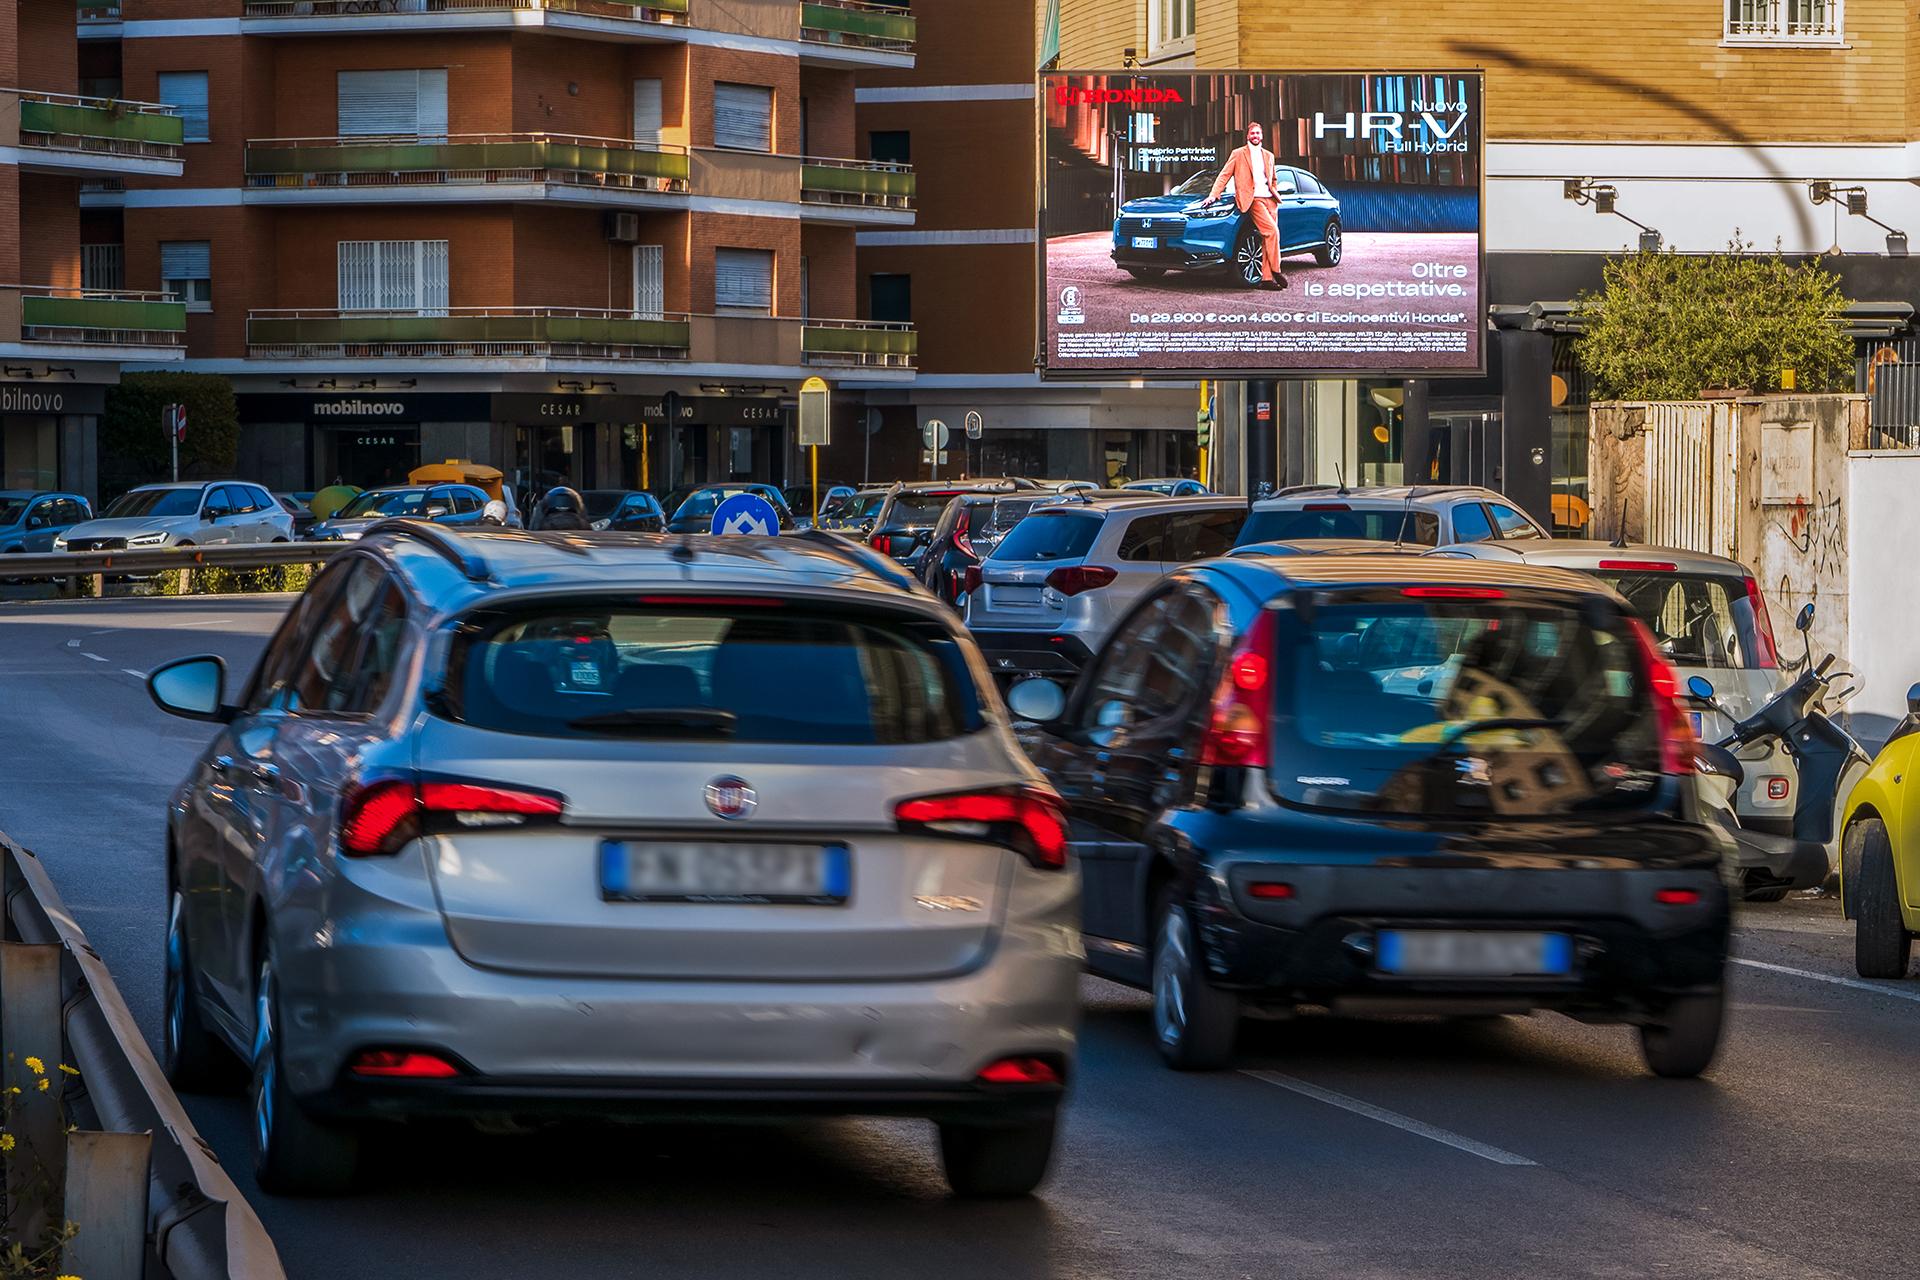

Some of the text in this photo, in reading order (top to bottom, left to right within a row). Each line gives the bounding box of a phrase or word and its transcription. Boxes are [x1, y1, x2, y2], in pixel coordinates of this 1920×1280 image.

[1081, 89, 1184, 103] HONDA
[1411, 100, 1468, 112] Nuovo
[1314, 112, 1468, 139] HR-V
[1138, 147, 1174, 156] Gregorio
[1385, 140, 1468, 154] Full Hybrid
[1138, 155, 1178, 163] Campione
[1411, 262, 1468, 278] Oltre
[1304, 280, 1467, 300] le aspettative.
[1130, 313, 1150, 323] Da
[1150, 313, 1204, 323] 29.900
[1205, 313, 1217, 323] €
[1218, 314, 1247, 323] con
[1248, 312, 1292, 323] 4.600
[1293, 312, 1305, 323] €
[1306, 312, 1320, 323] di
[0, 387, 63, 411] bilnovo
[313, 400, 404, 415] mobilnovo
[540, 403, 581, 416] CESAR
[743, 407, 779, 419] CESAR
[357, 437, 395, 445] CESAR
